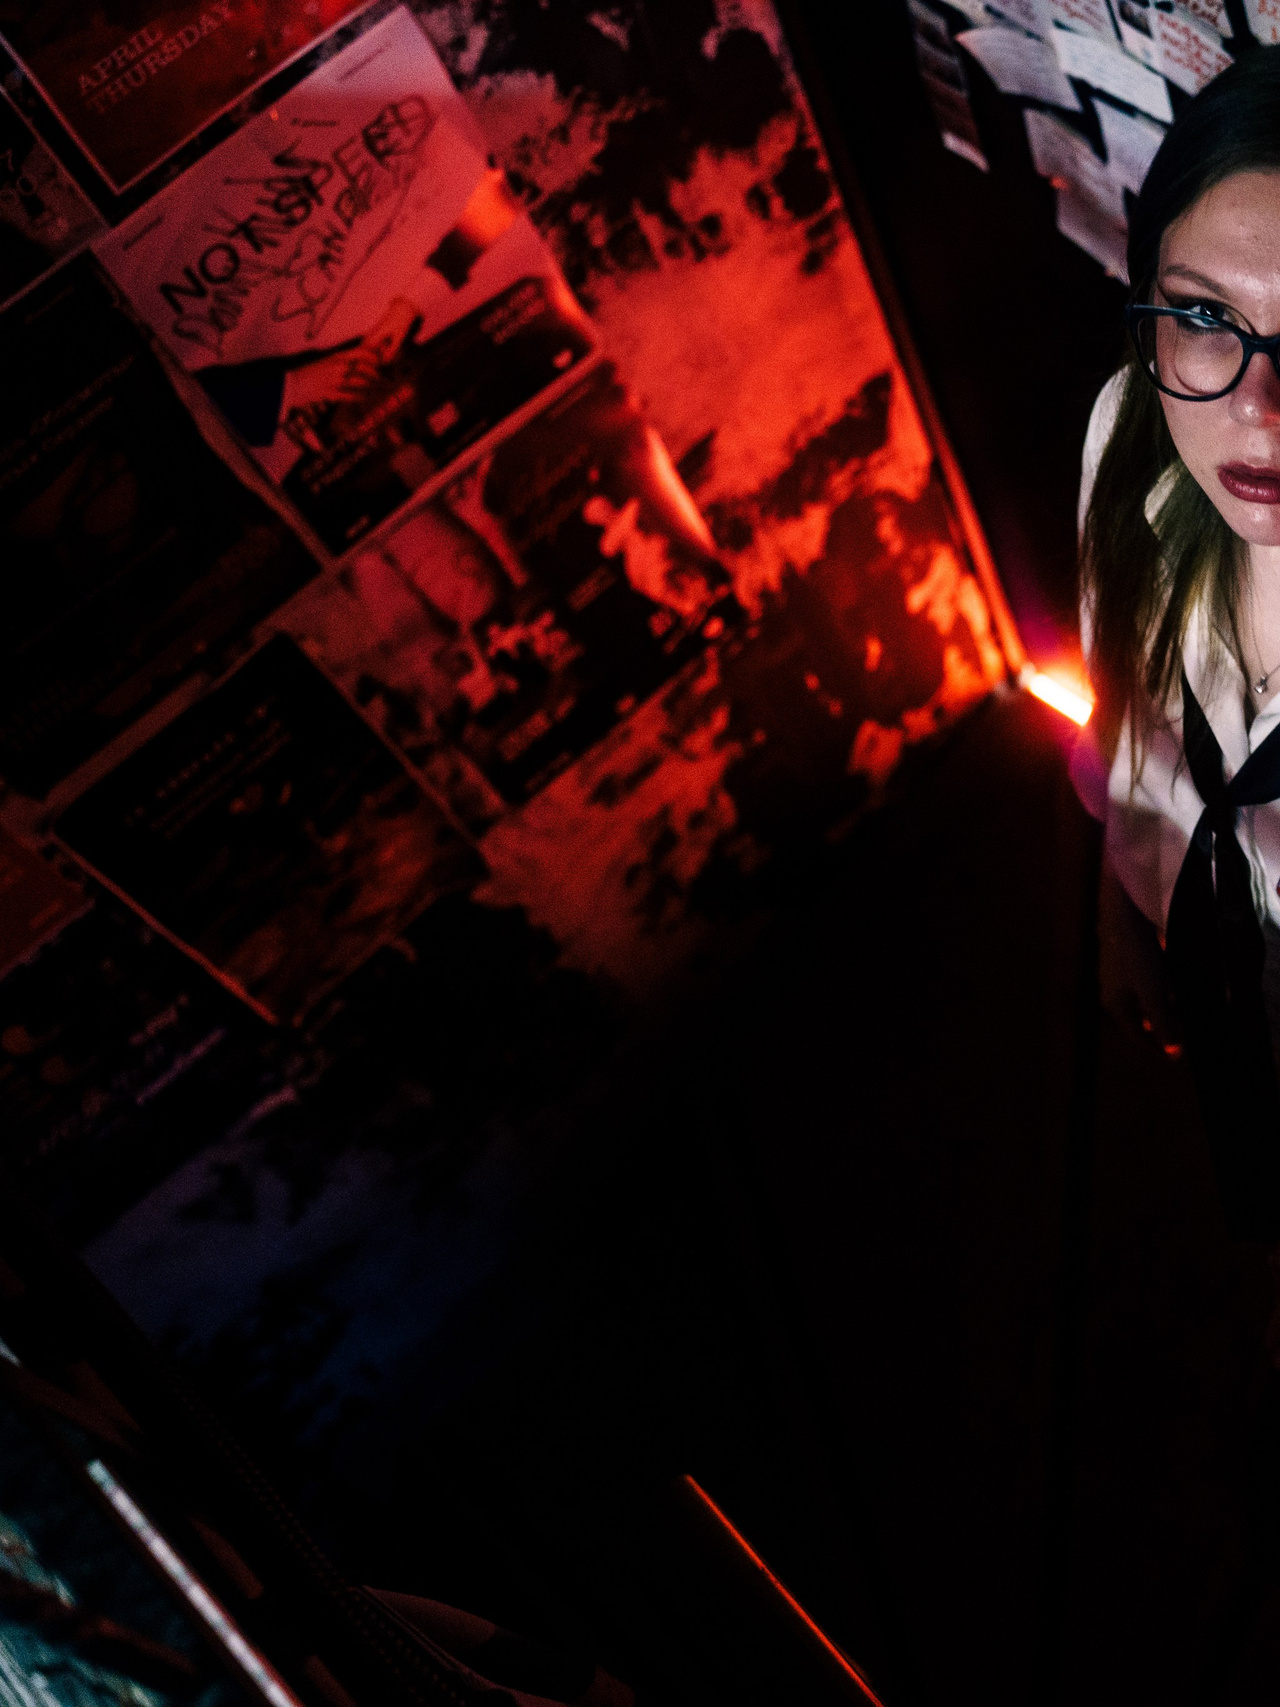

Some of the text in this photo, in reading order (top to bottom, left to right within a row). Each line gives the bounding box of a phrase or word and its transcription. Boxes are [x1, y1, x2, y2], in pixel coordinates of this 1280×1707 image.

[77, 25, 165, 97] APRIL
[87, 4, 238, 114] THURSDAY
[159, 219, 278, 313] NOT
